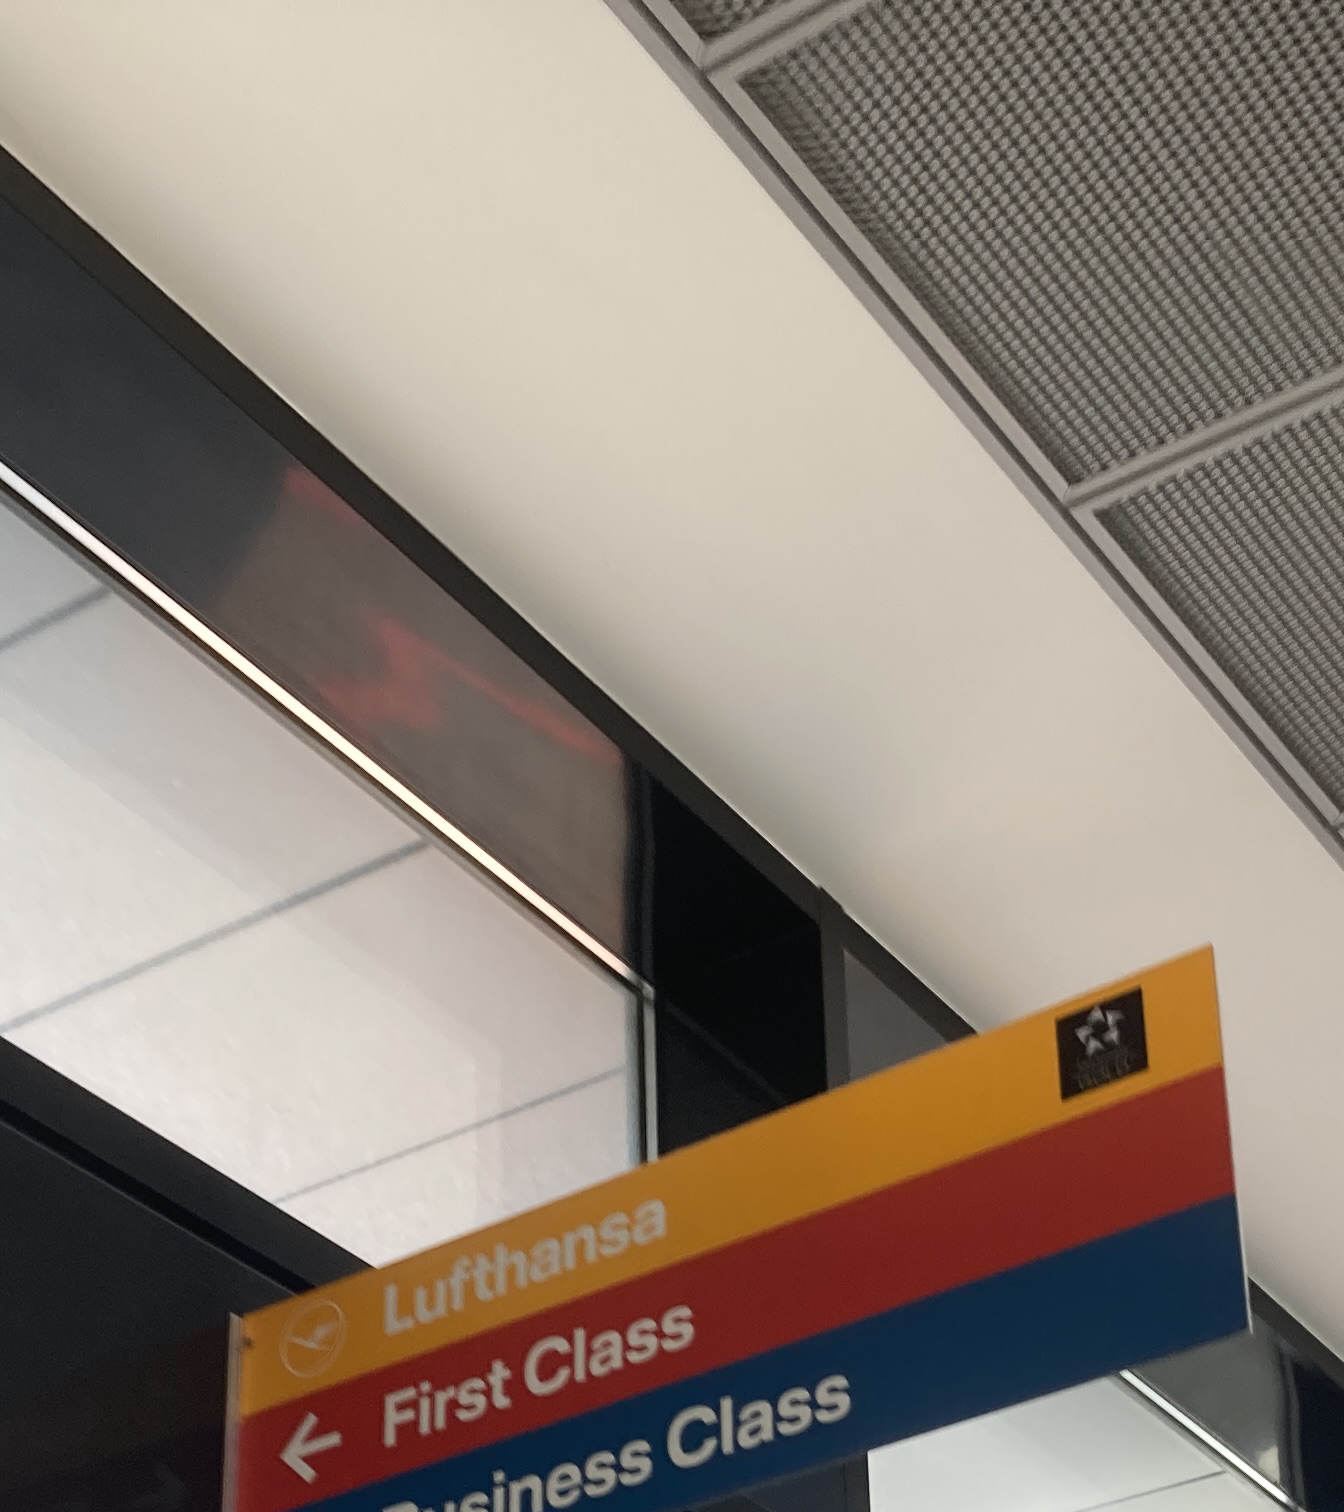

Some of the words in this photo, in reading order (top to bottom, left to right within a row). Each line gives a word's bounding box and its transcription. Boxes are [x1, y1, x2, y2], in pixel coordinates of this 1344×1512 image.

[382, 1199, 668, 1336] Lufthansa
[382, 1357, 512, 1448] First
[524, 1304, 695, 1398] Class
[666, 1374, 853, 1469] Class
